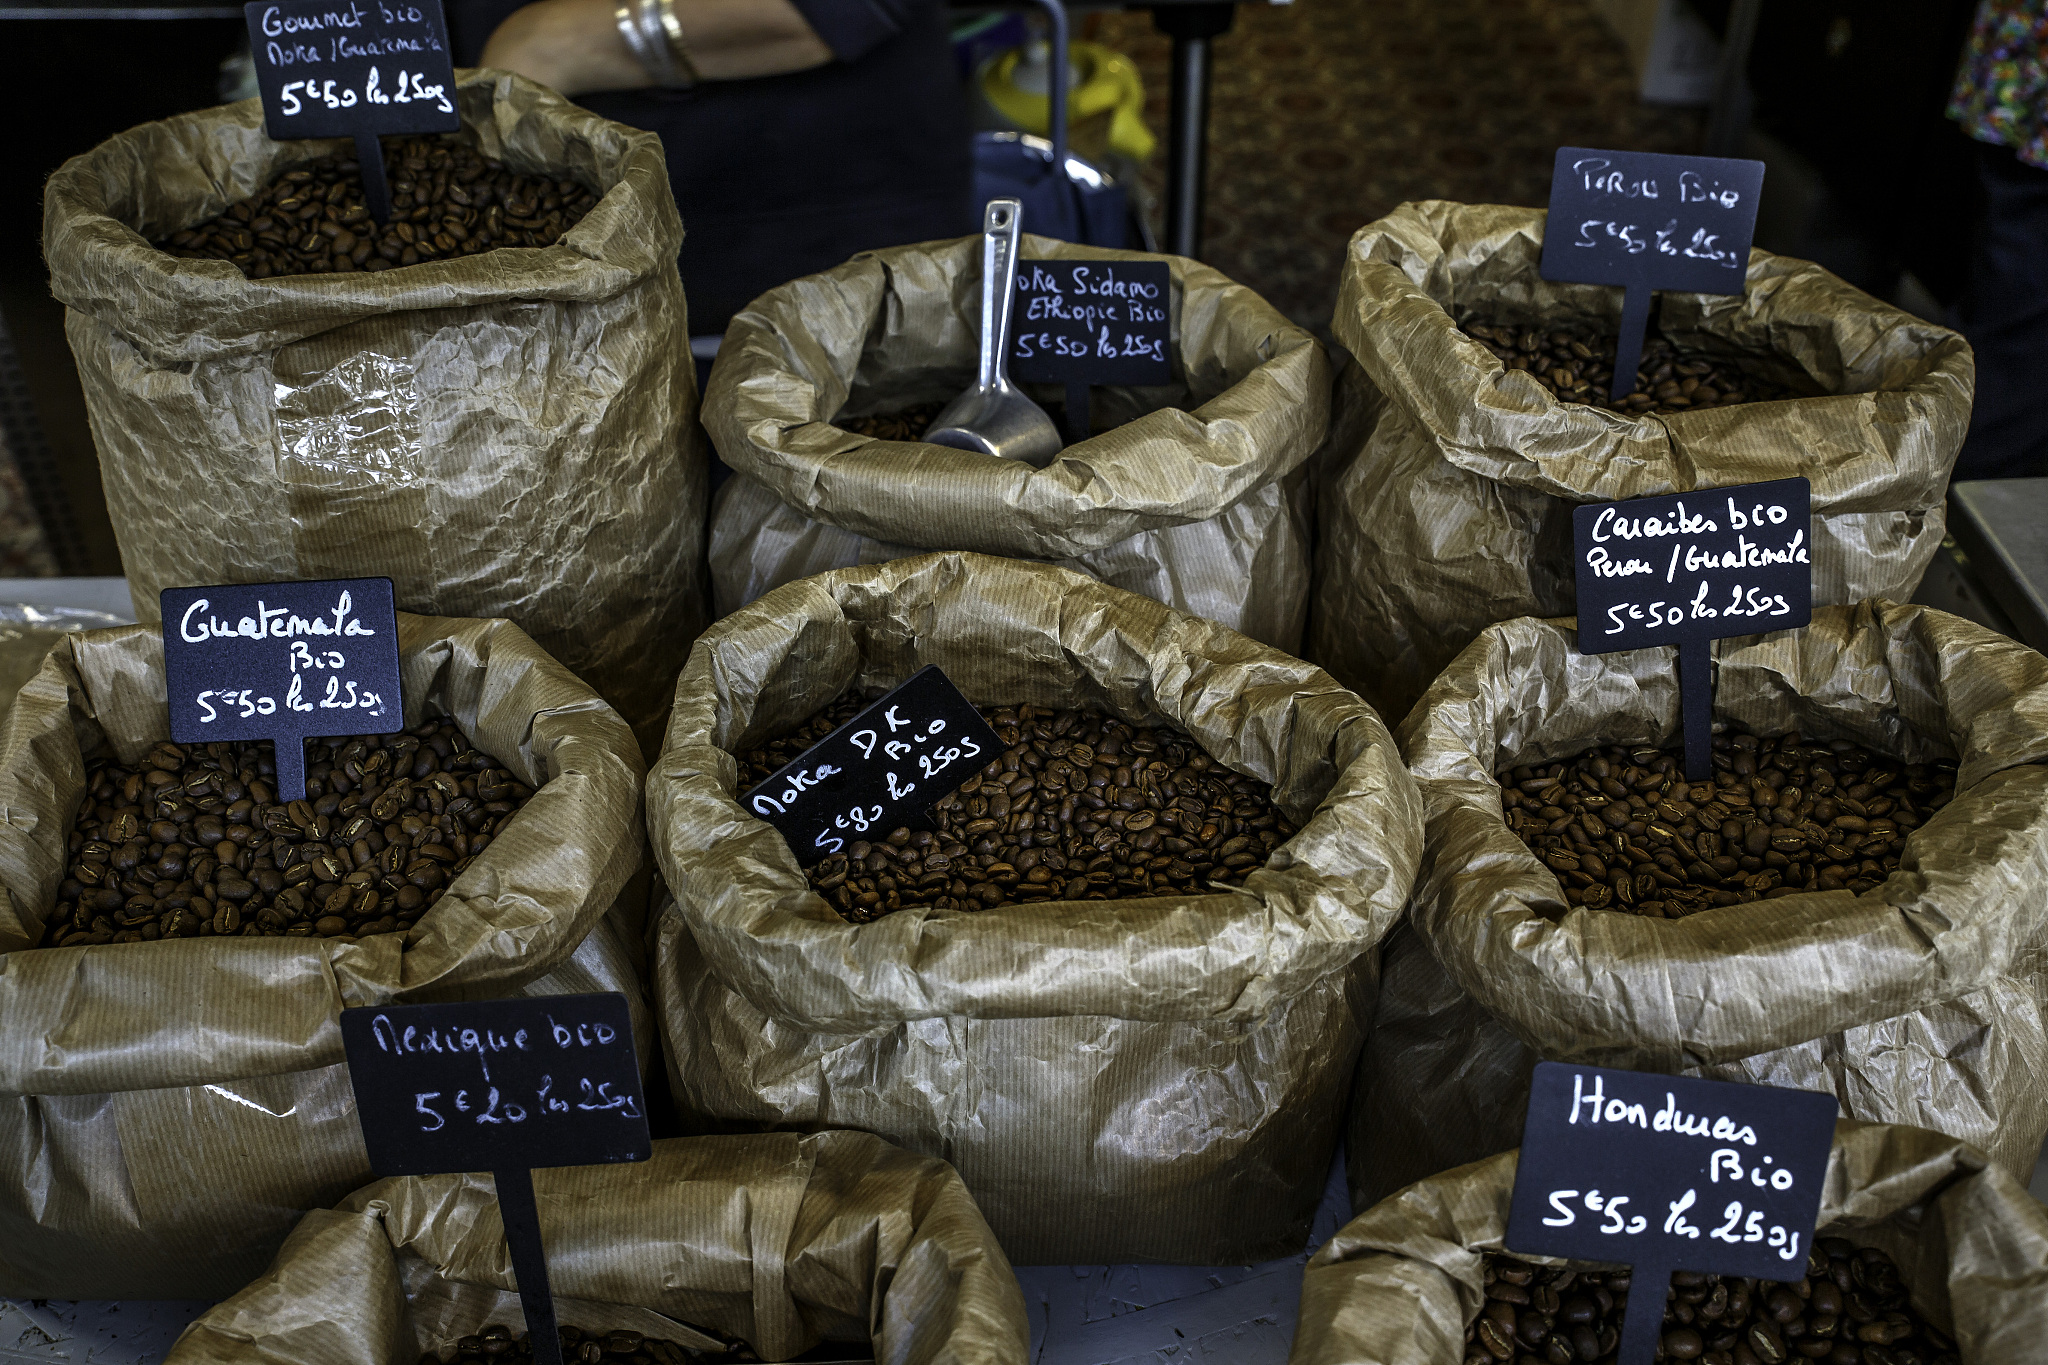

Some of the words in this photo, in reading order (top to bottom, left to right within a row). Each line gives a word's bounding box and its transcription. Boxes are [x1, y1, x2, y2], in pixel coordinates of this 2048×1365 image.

[261, 1, 367, 39] Gourmet
[378, 1, 423, 24] bio
[1679, 170, 1740, 209] Bio
[1072, 266, 1159, 299] Sidamo
[1127, 298, 1165, 323] Bio
[1727, 496, 1788, 531] bio
[180, 589, 376, 646] Guatemala
[289, 640, 346, 674] Bio
[548, 1013, 616, 1050] bio
[1568, 1071, 1759, 1146] Honduras
[1709, 1148, 1794, 1191] Bio
